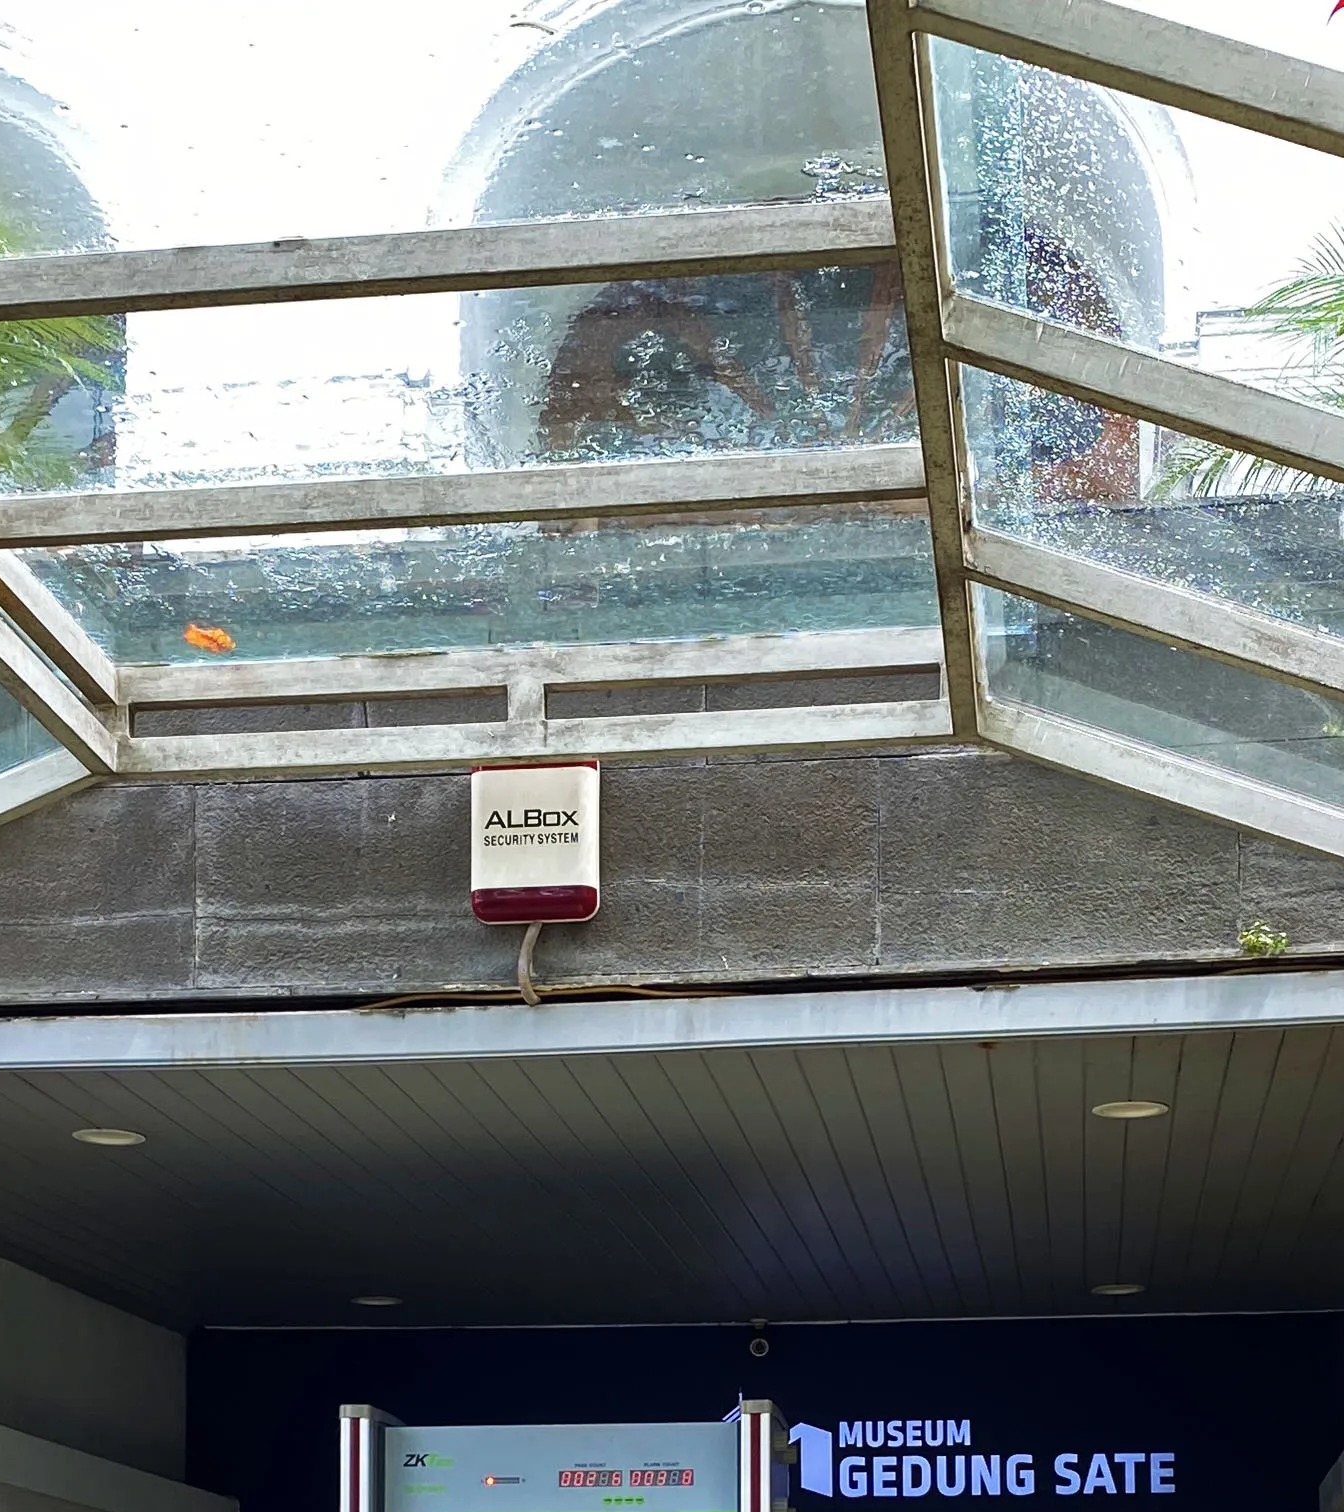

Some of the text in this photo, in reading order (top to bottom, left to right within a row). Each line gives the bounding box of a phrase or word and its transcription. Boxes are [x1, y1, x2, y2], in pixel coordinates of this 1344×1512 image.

[483, 832, 580, 847] SECURITY SYSTEM
[838, 1419, 972, 1449] MUSEUM
[838, 1452, 1177, 1499] GEDUNG SATE
